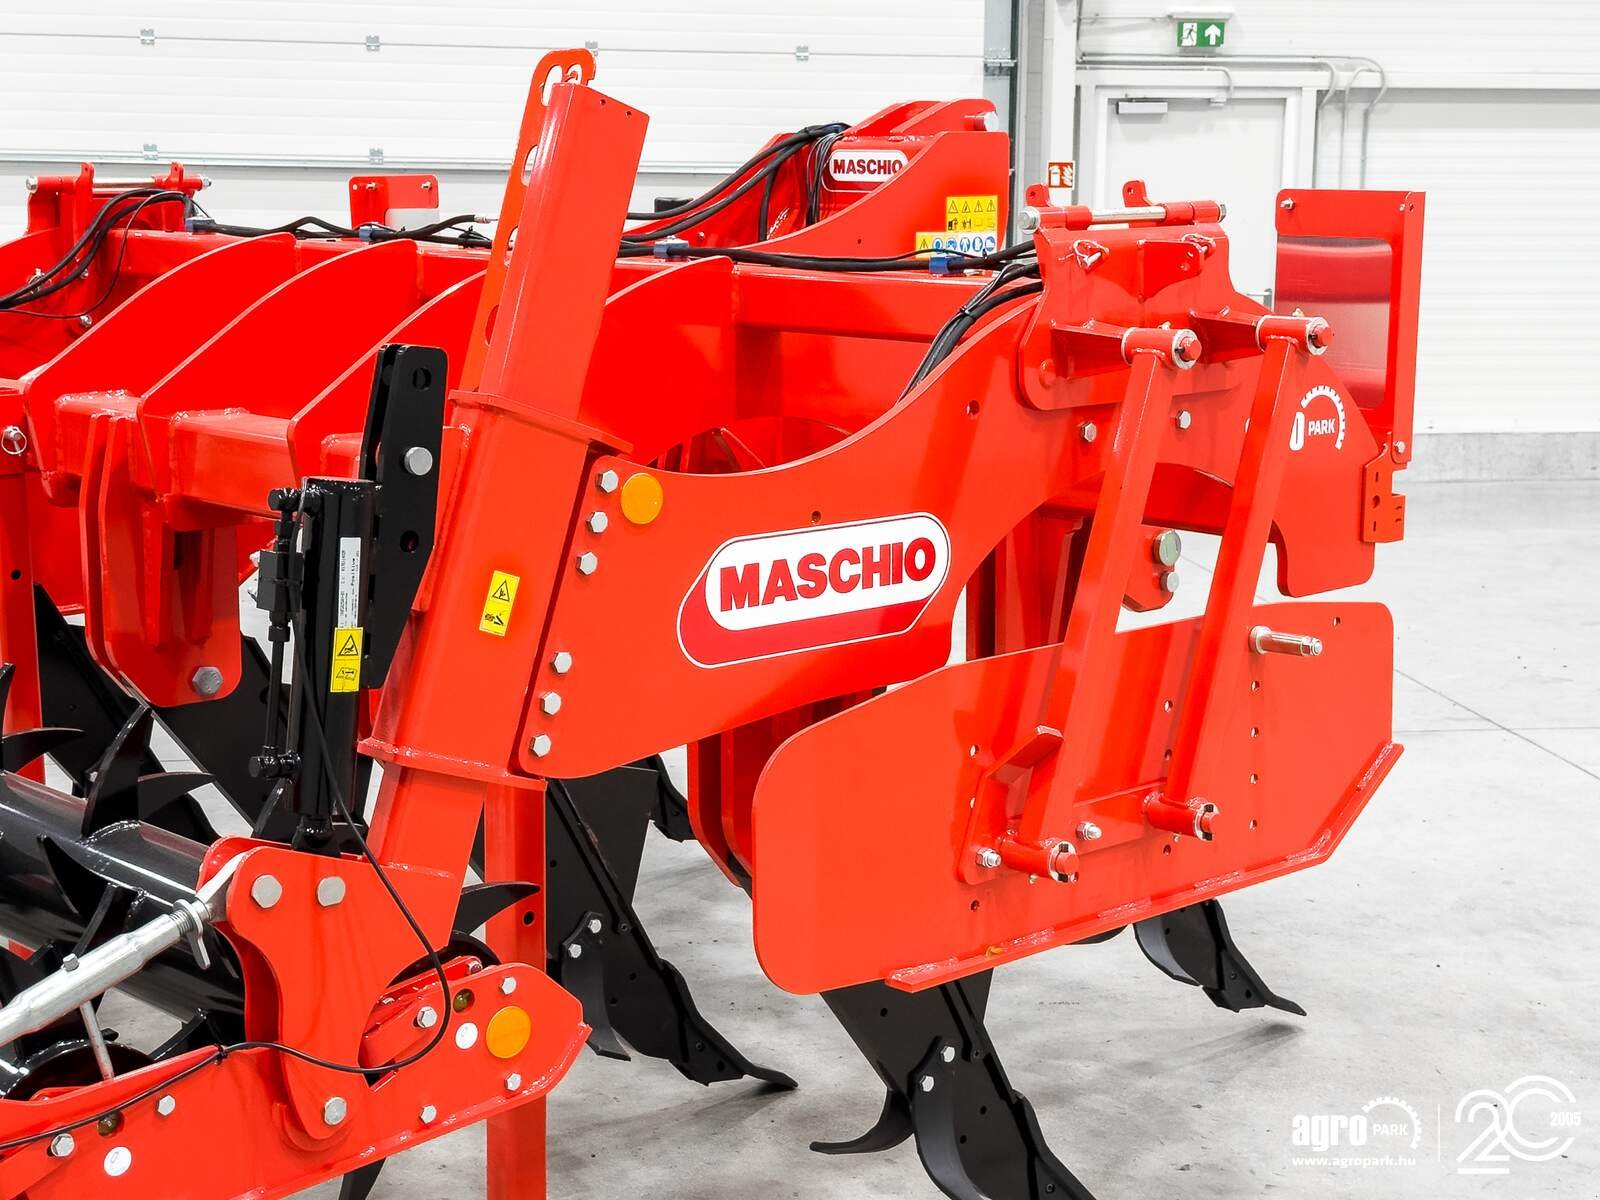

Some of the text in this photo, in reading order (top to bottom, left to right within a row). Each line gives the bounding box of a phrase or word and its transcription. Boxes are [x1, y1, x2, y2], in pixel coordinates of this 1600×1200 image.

[832, 158, 903, 175] MASCHIO
[1308, 418, 1336, 437] PARK
[719, 536, 937, 612] MASCHIO
